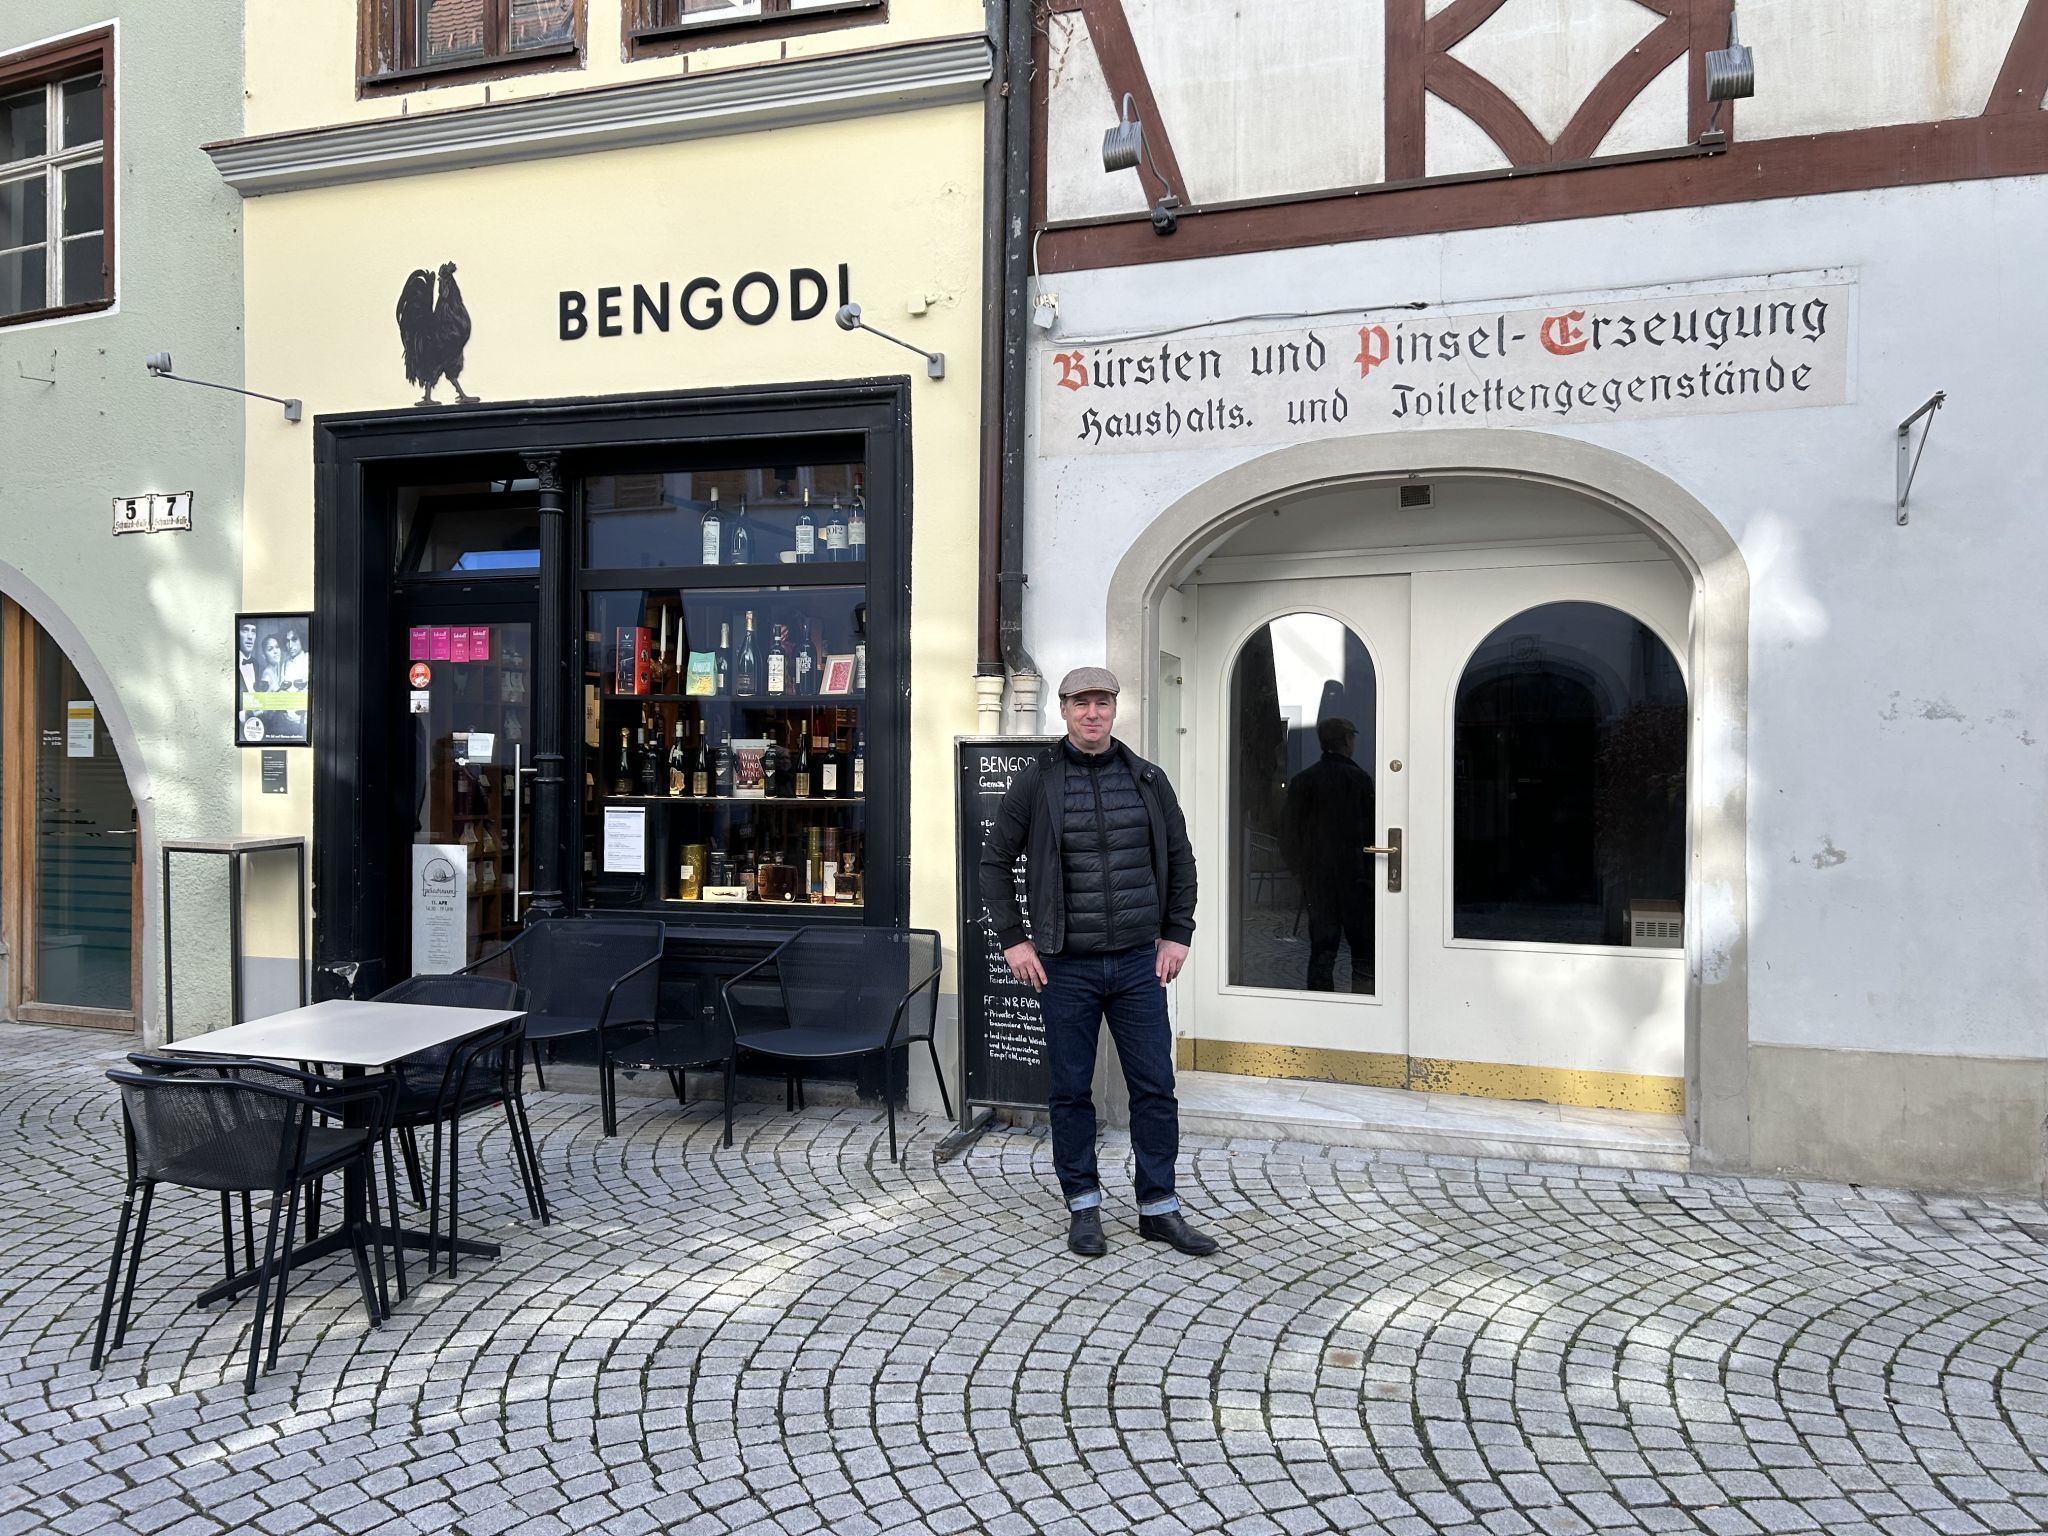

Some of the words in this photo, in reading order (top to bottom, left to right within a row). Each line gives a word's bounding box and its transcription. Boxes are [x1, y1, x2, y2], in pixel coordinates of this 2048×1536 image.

[559, 262, 849, 341] BENGODI
[1053, 343, 1222, 392] Bürsten
[1250, 330, 1326, 377] und
[1353, 315, 1526, 380] Pinsel-
[1539, 297, 1830, 357] Erzeugung
[1287, 386, 1349, 426] und
[1391, 355, 1813, 420] Toilettengegenstände
[126, 500, 136, 519] 5
[167, 497, 176, 516] 7
[741, 769, 760, 779] WINE
[742, 760, 759, 769] VINO
[1012, 996, 1020, 1008] &
[1020, 997, 1040, 1009] EVEN
[989, 1009, 1015, 1020] Privater
